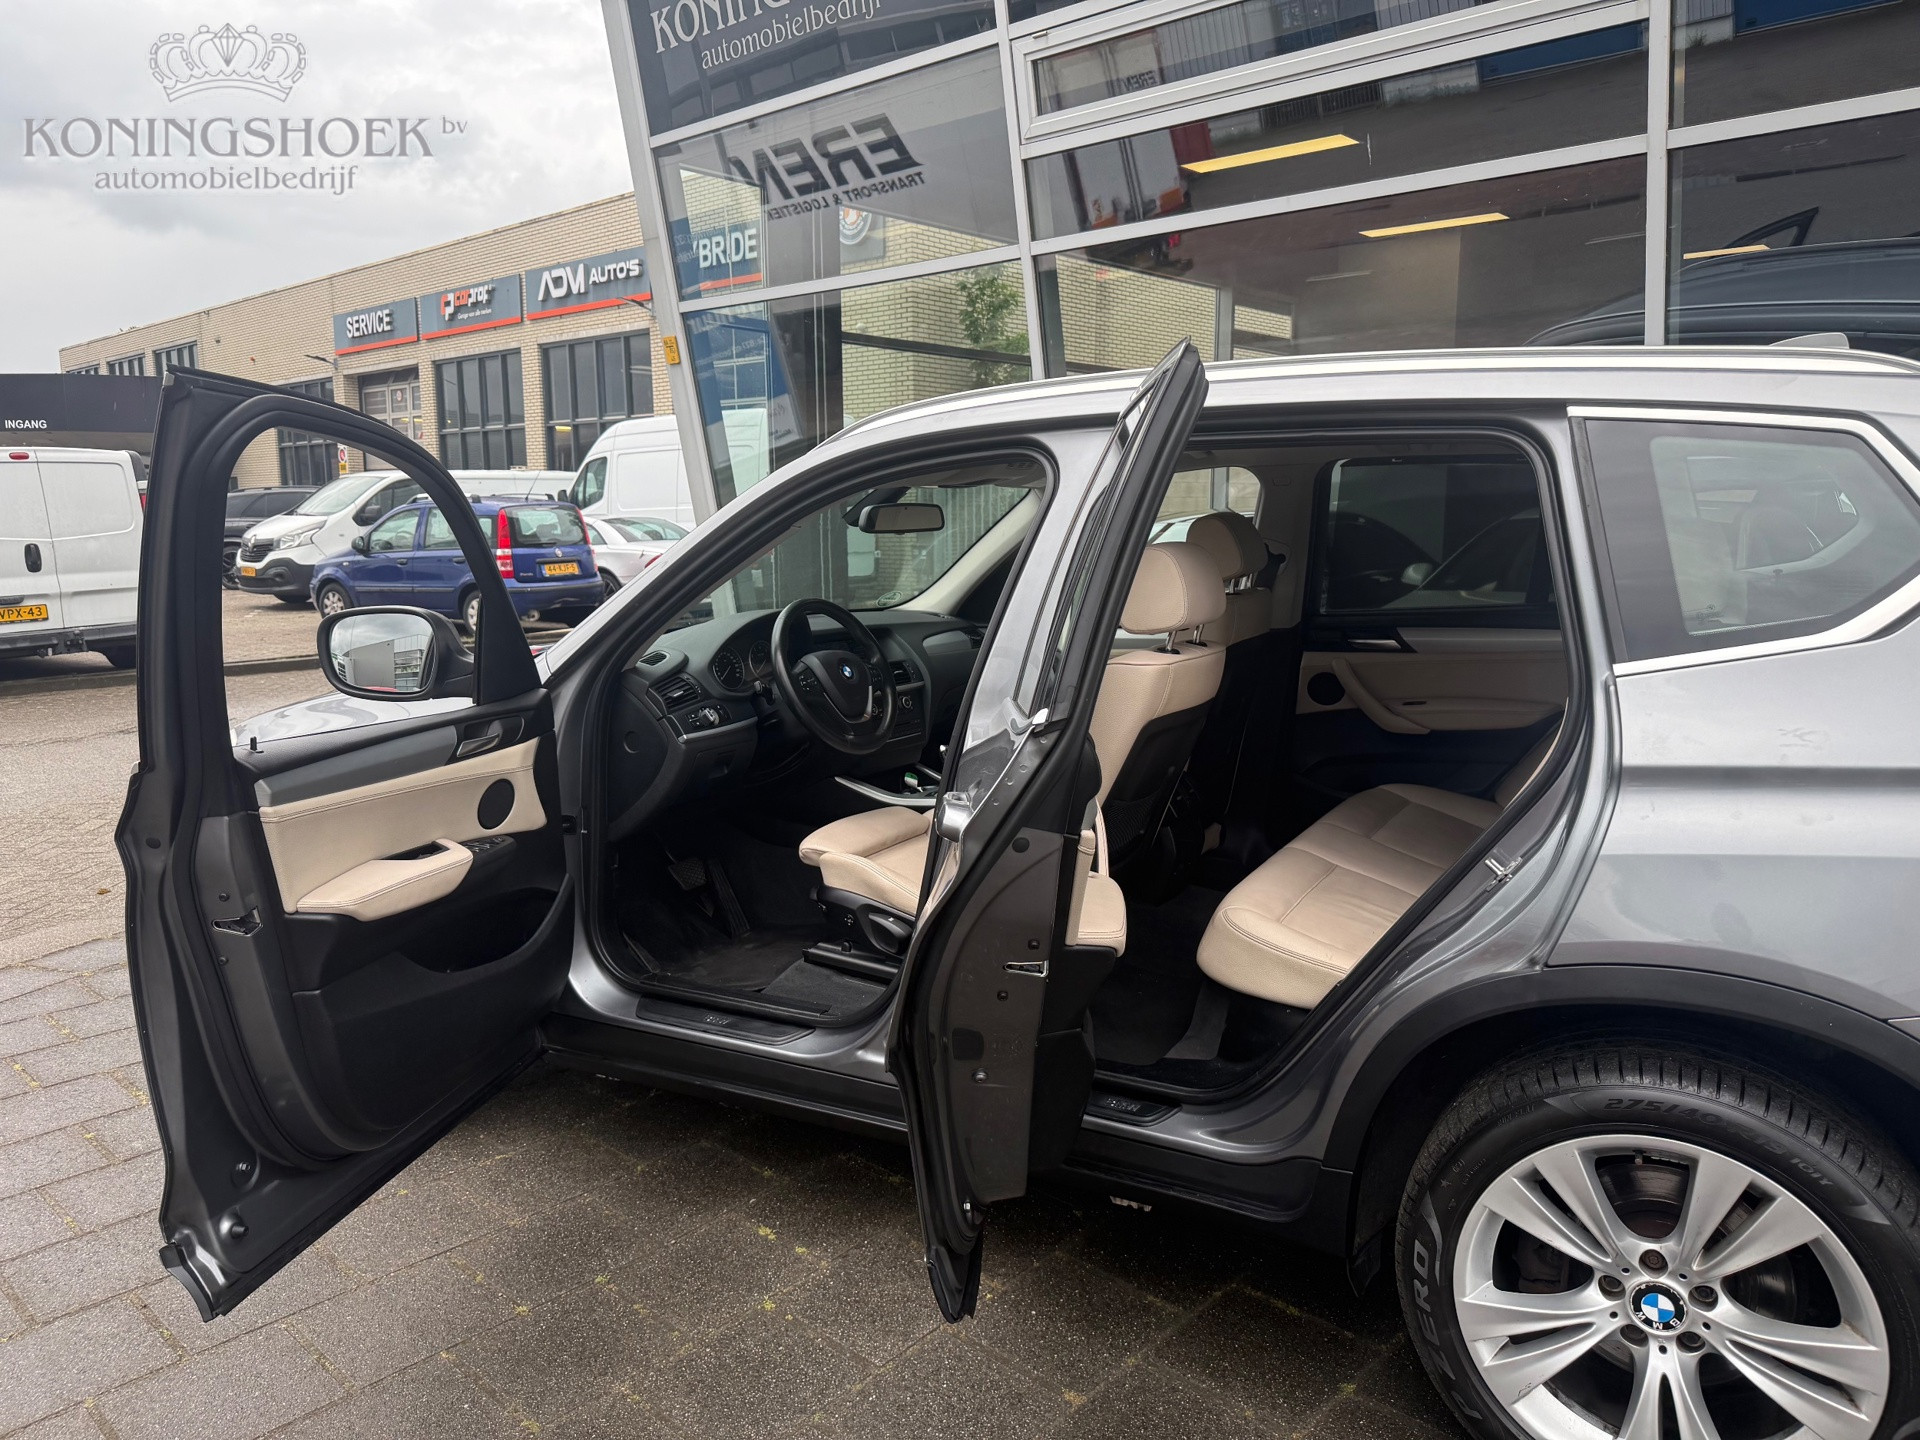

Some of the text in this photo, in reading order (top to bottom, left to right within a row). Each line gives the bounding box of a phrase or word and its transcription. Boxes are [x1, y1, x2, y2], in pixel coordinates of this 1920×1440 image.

[589, 258, 640, 285] AUTO'S
[346, 309, 391, 338] SERVICE
[4, 419, 48, 429] INGANG
[1413, 1238, 1456, 1381] ZERO
